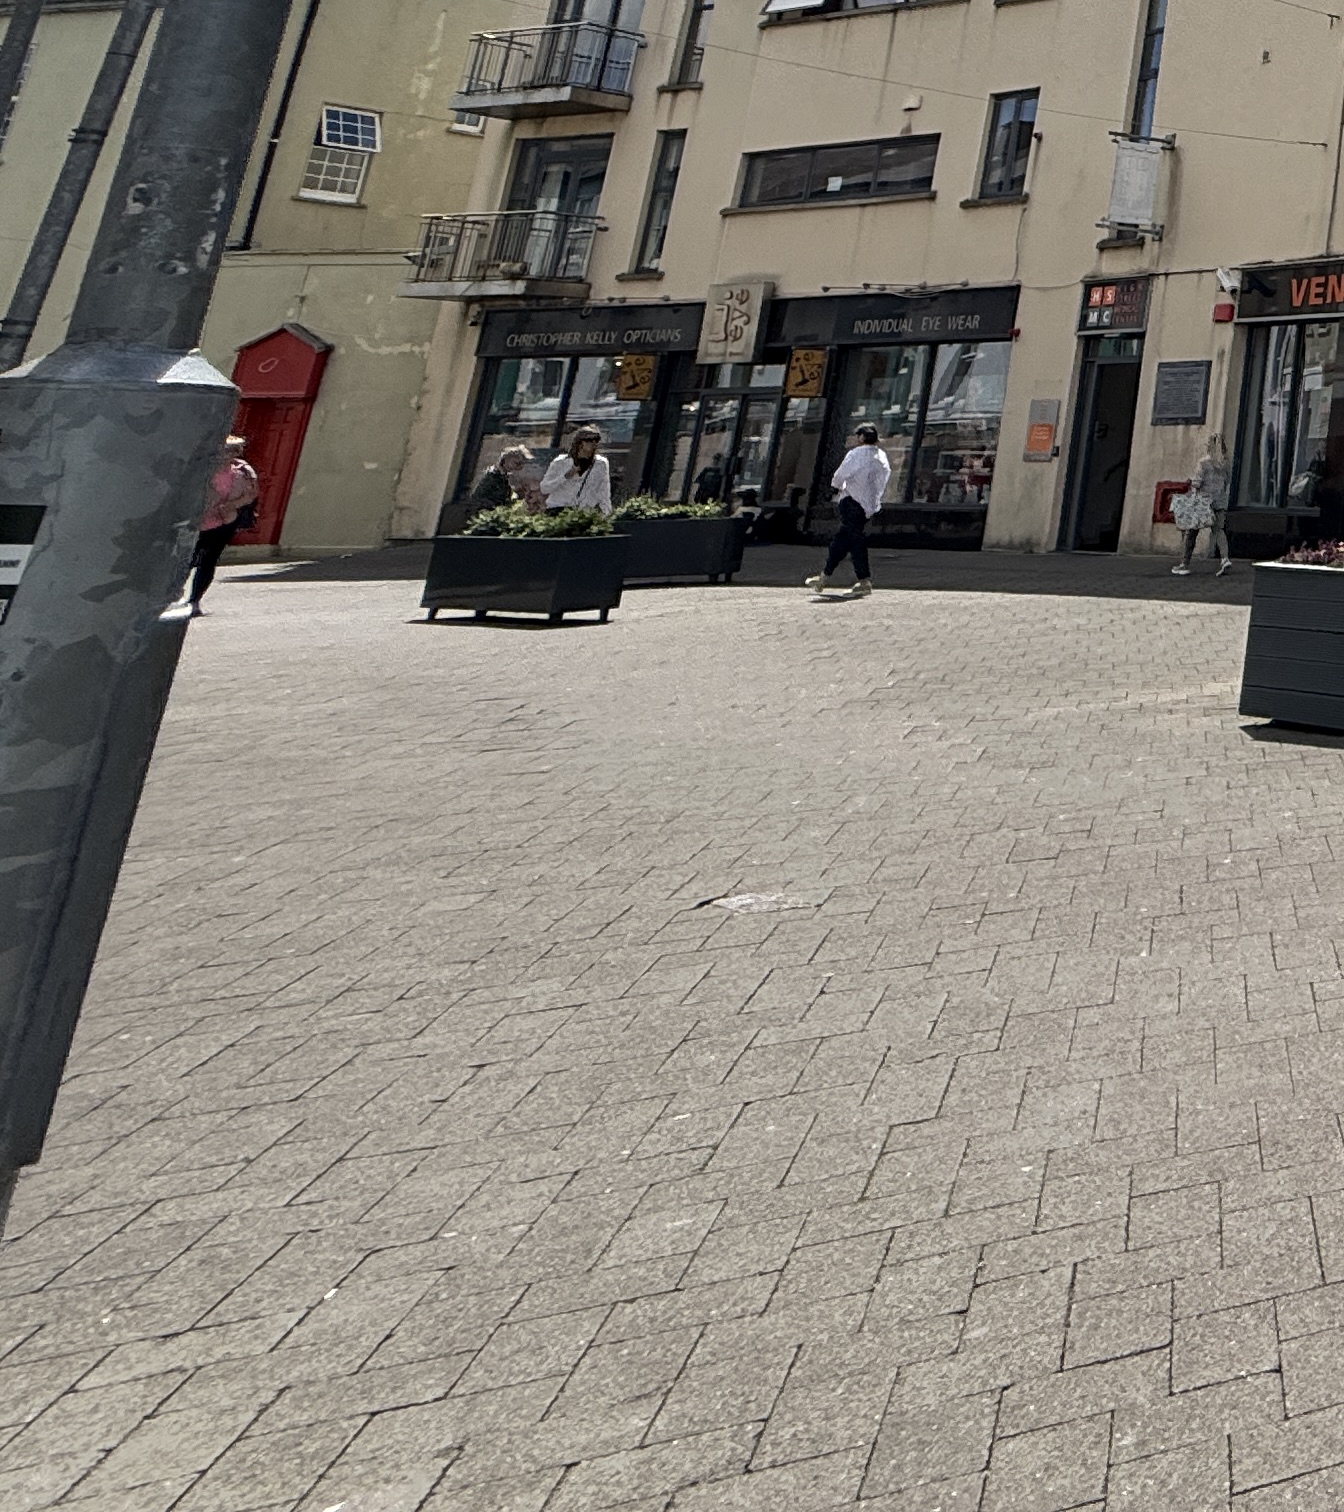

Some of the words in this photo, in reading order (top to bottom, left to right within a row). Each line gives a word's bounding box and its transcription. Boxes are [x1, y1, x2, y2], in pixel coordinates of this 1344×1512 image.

[853, 317, 914, 335] INDIVIDUAL
[921, 316, 942, 331] EYE
[947, 314, 981, 331] WEAR
[506, 331, 582, 348] CHRISTOPHER
[585, 330, 619, 345] KELLY
[623, 328, 682, 345] OPTICIANS
